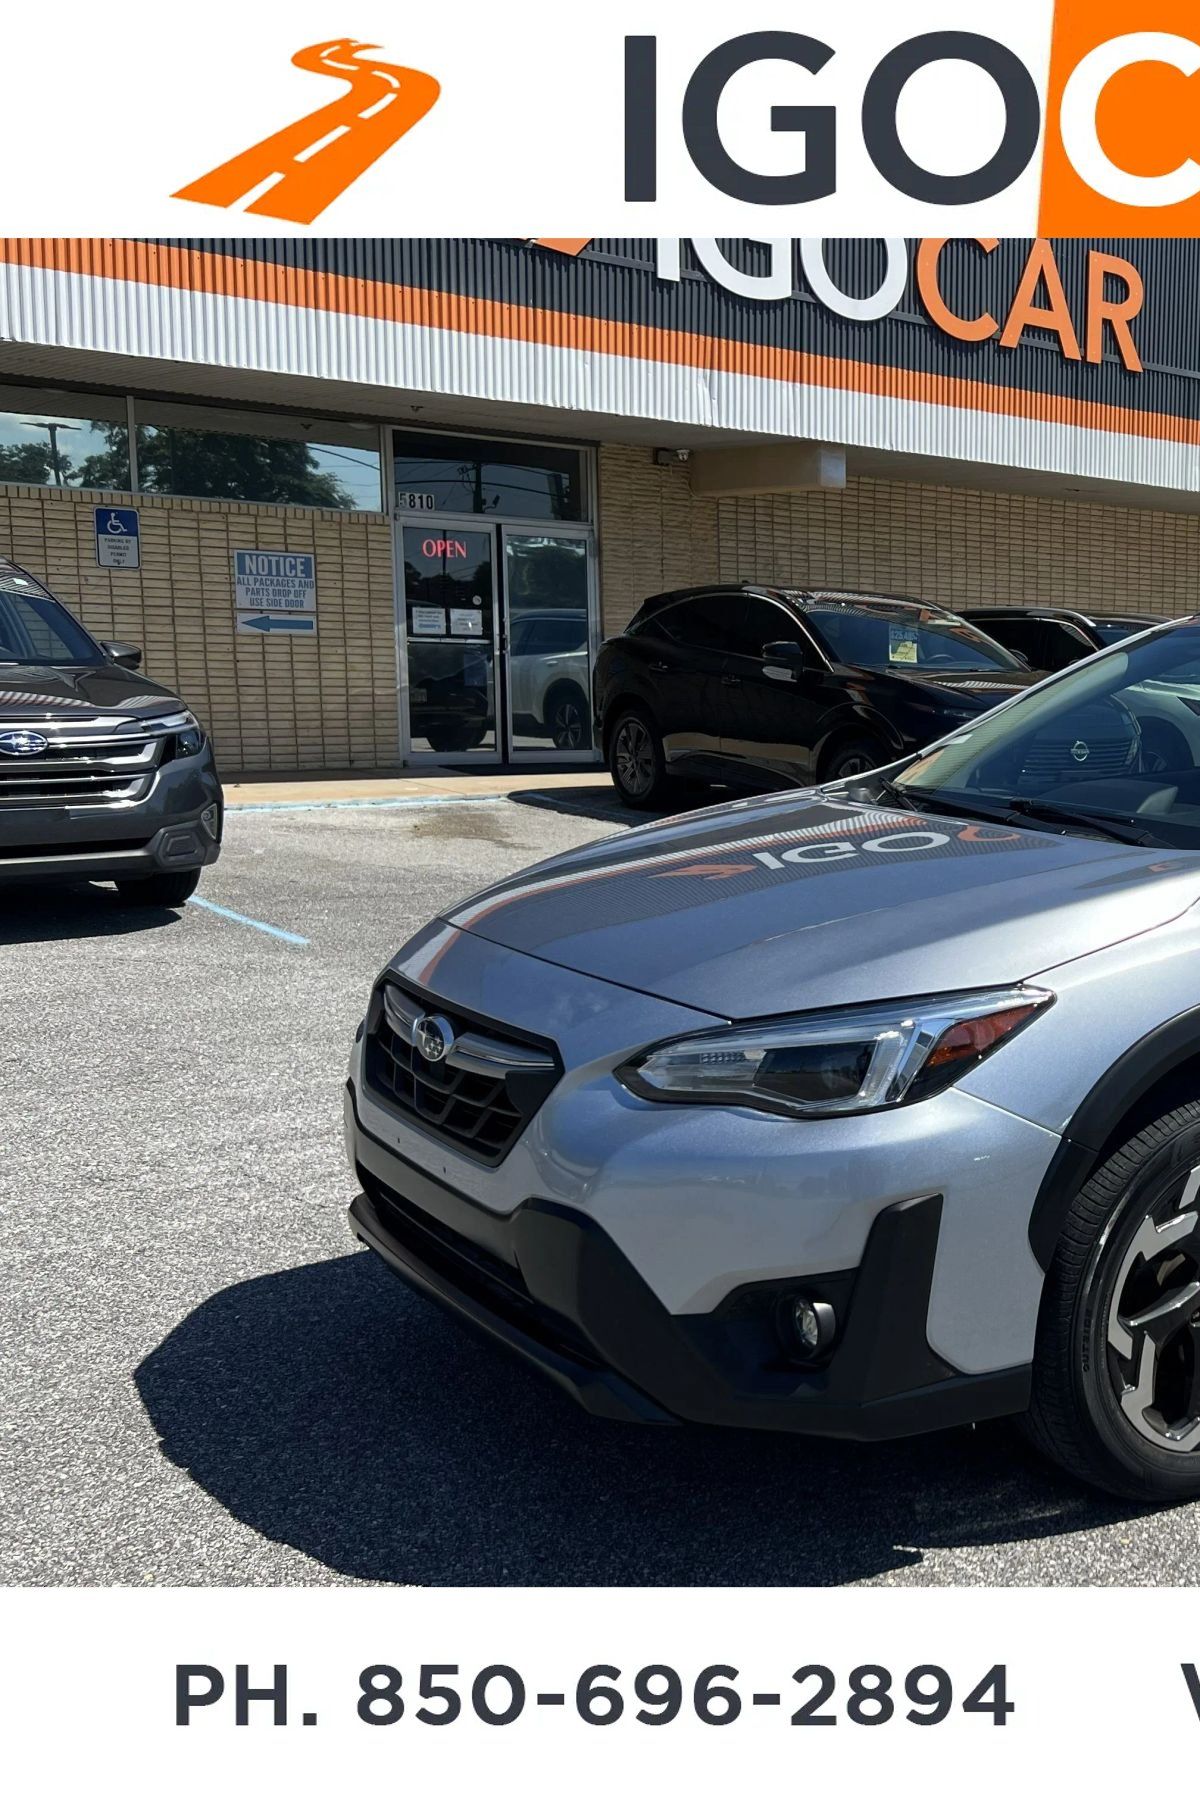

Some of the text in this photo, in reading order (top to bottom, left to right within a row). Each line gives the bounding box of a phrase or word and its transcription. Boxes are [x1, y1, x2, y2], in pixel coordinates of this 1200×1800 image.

[422, 538, 467, 559] OPEN
[245, 554, 306, 578] NOTICE
[236, 575, 315, 590] ALL PACKAGES AND
[245, 587, 307, 599] PARTS DROP OFF
[249, 597, 304, 608] USE SIDE DOOR
